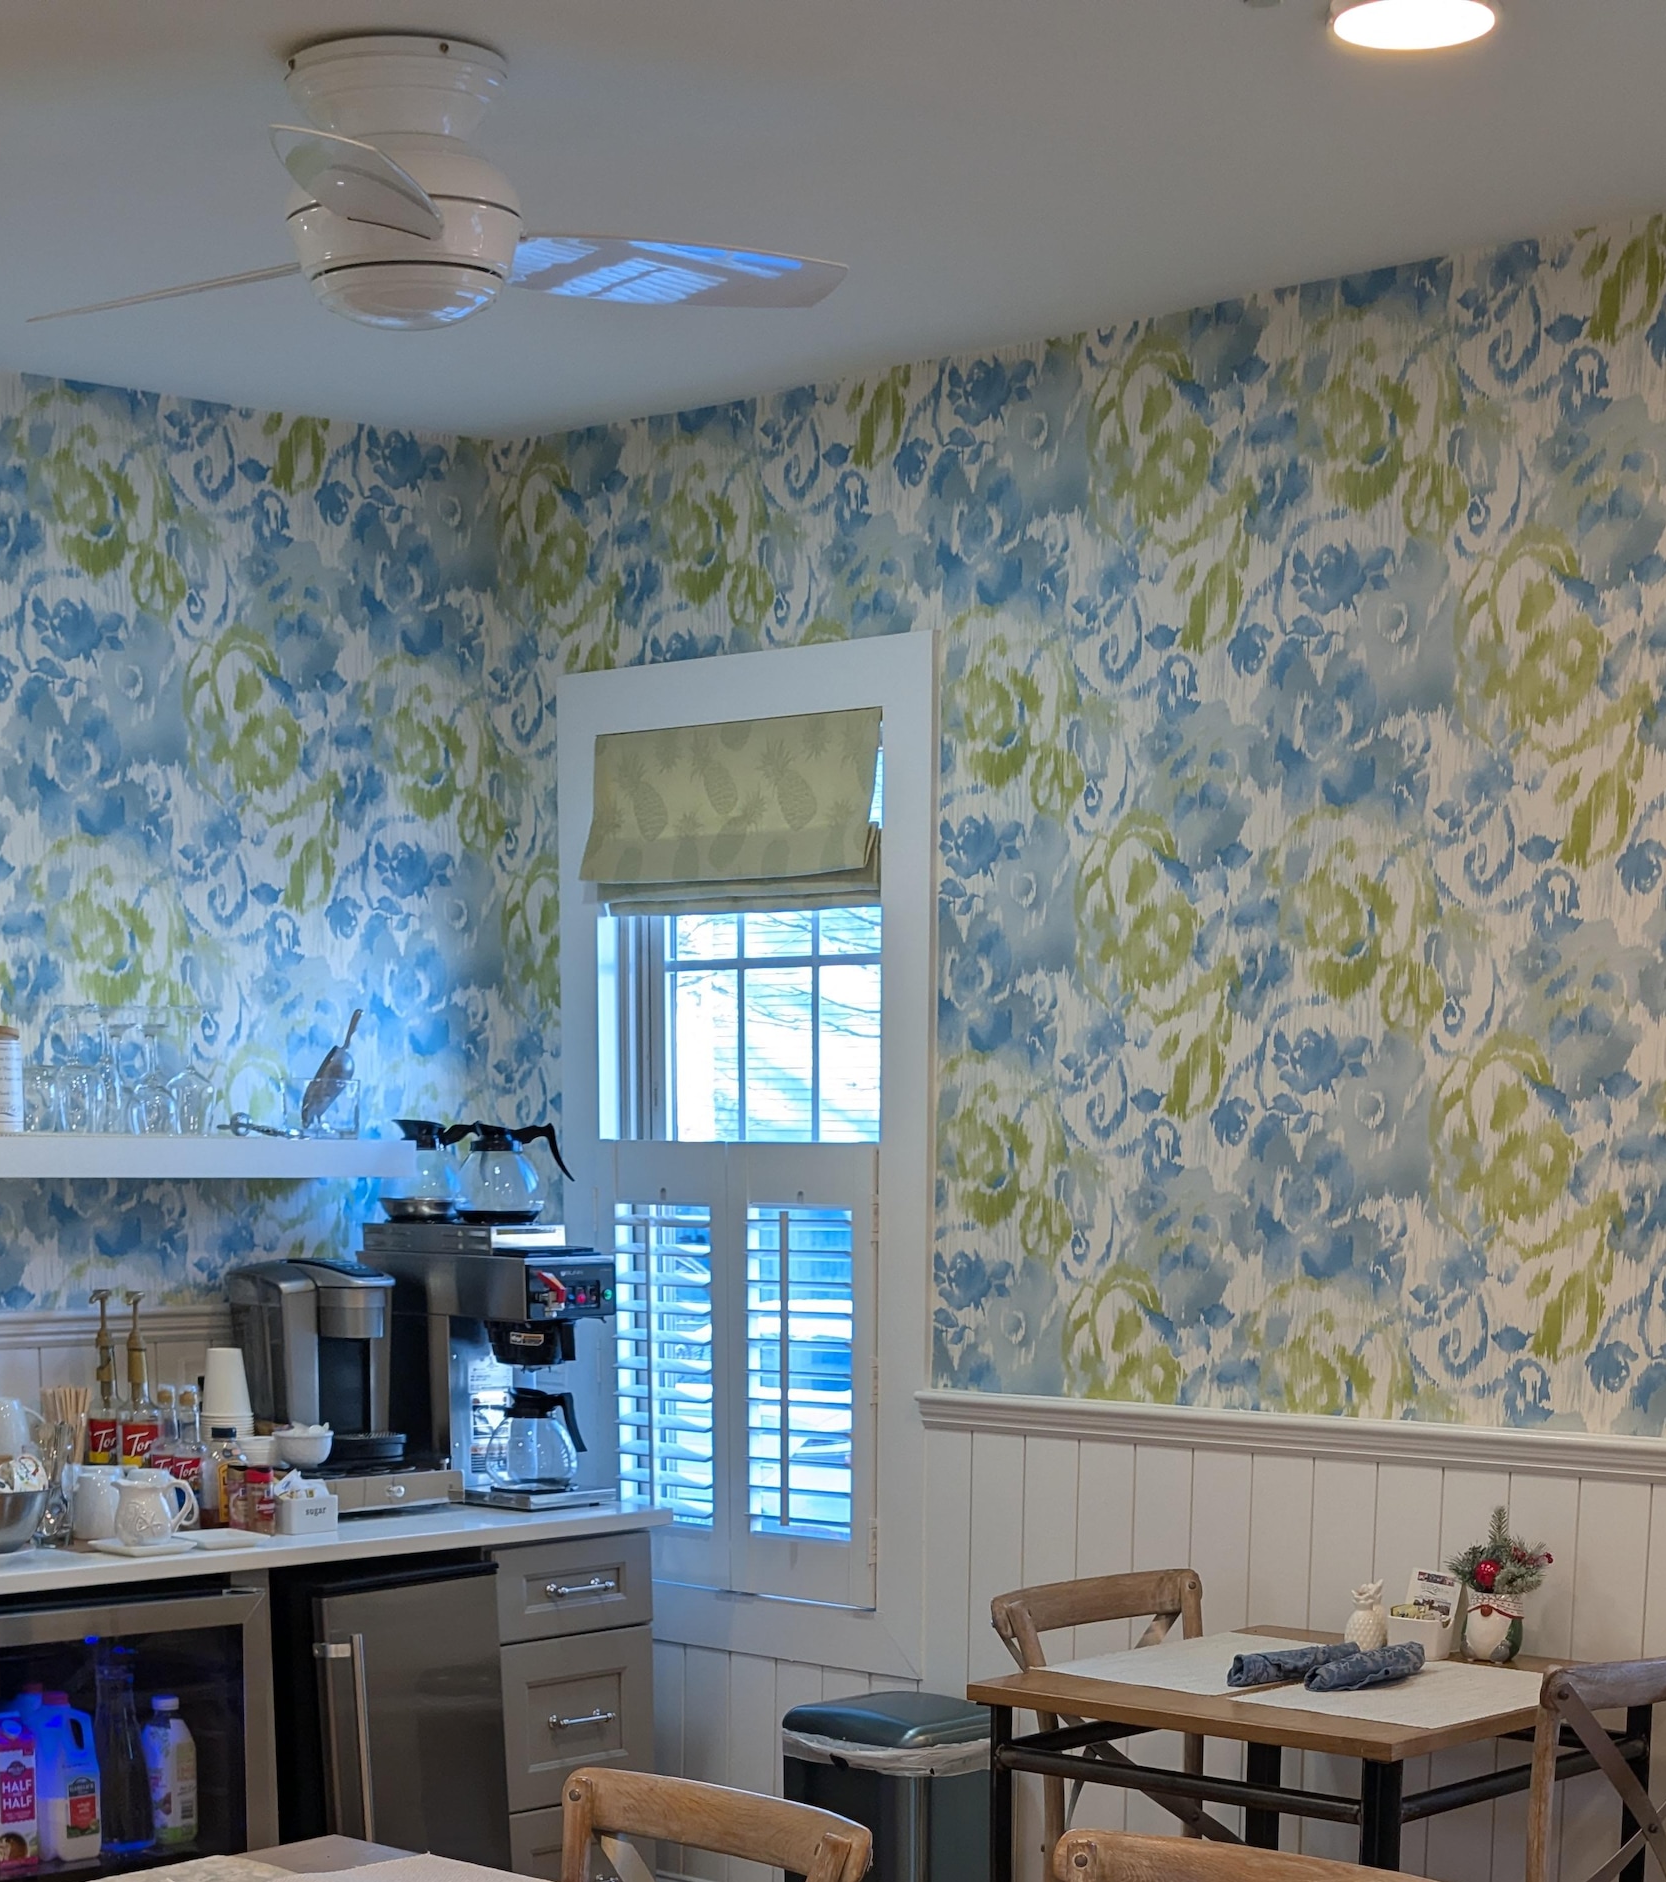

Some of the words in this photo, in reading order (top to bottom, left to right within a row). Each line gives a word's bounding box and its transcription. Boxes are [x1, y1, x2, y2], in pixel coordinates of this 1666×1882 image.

[305, 1506, 327, 1517] sugar
[2, 1779, 33, 1794] HALF
[3, 1795, 33, 1810] HALF
